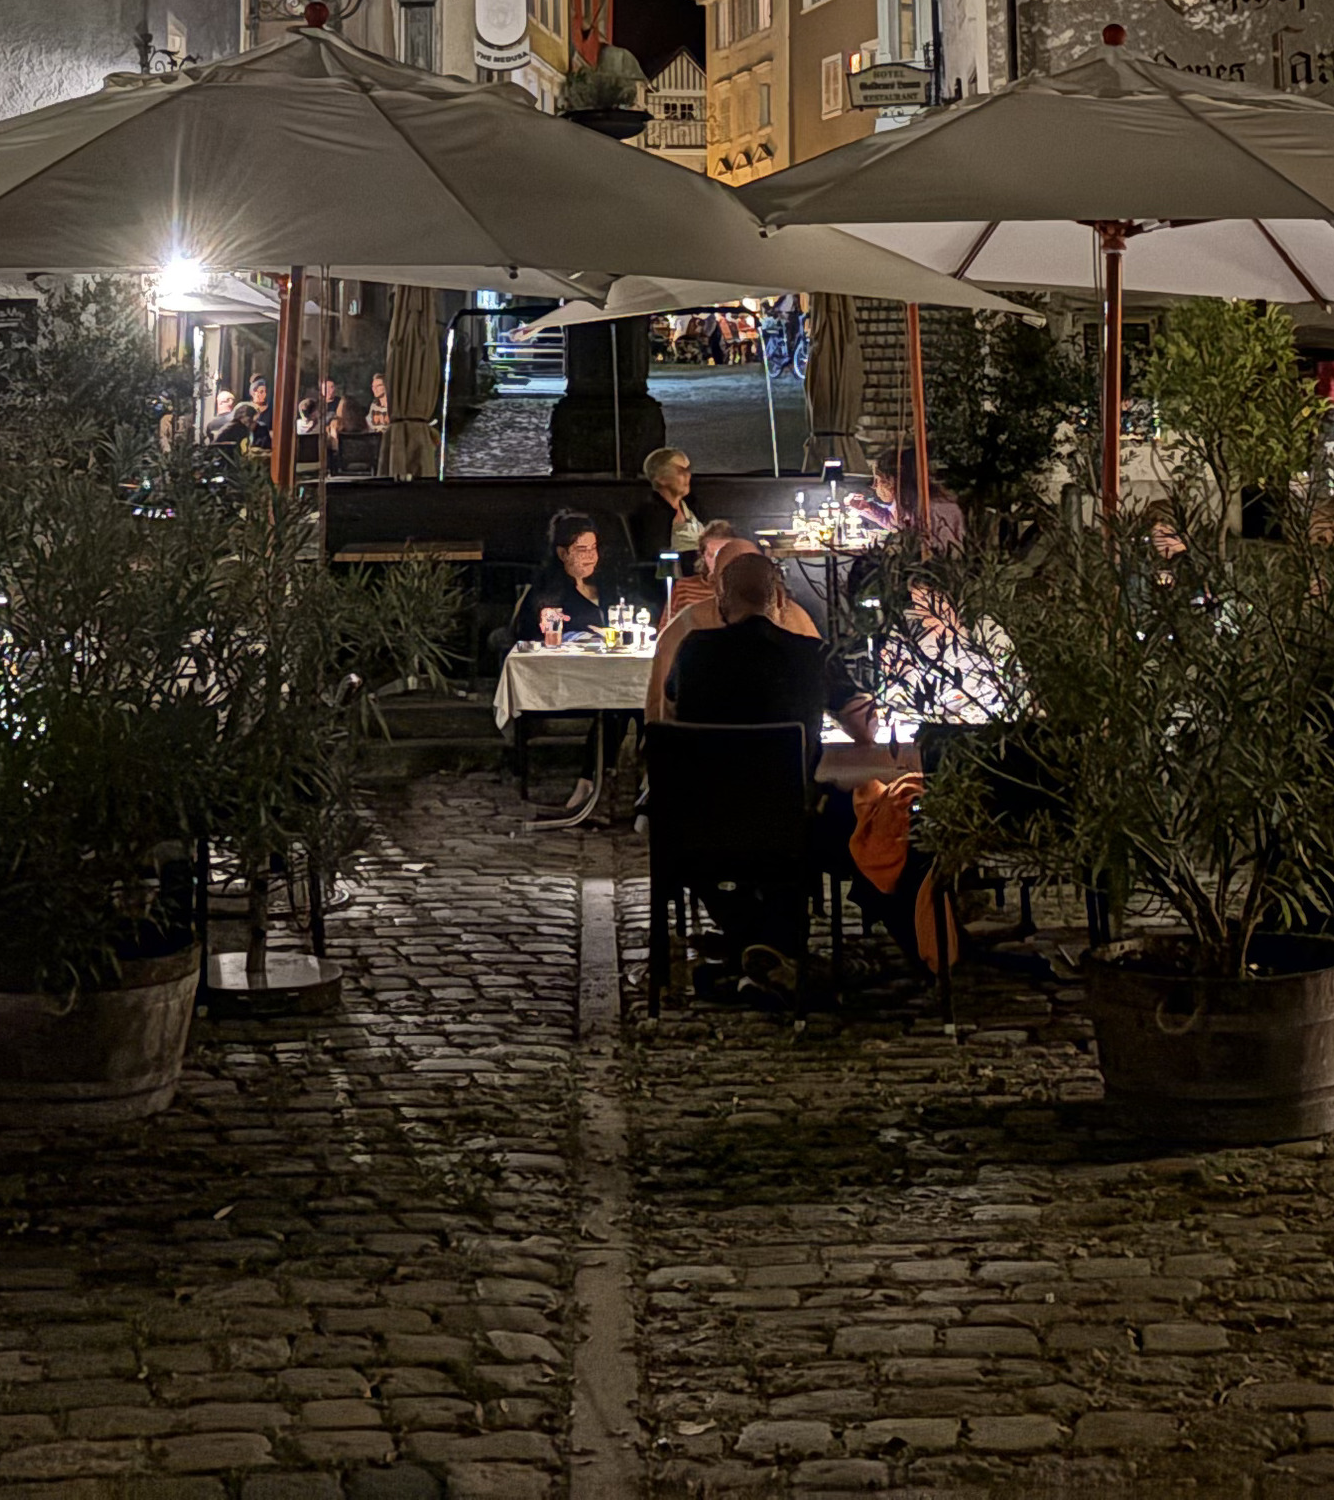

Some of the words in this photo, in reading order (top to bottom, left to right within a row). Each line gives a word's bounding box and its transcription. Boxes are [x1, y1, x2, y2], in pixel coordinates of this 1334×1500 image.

[476, 50, 493, 63] THE
[493, 50, 530, 63] MEDUSA
[872, 70, 906, 79] HOTEL
[862, 92, 919, 102] RESTAURANT
